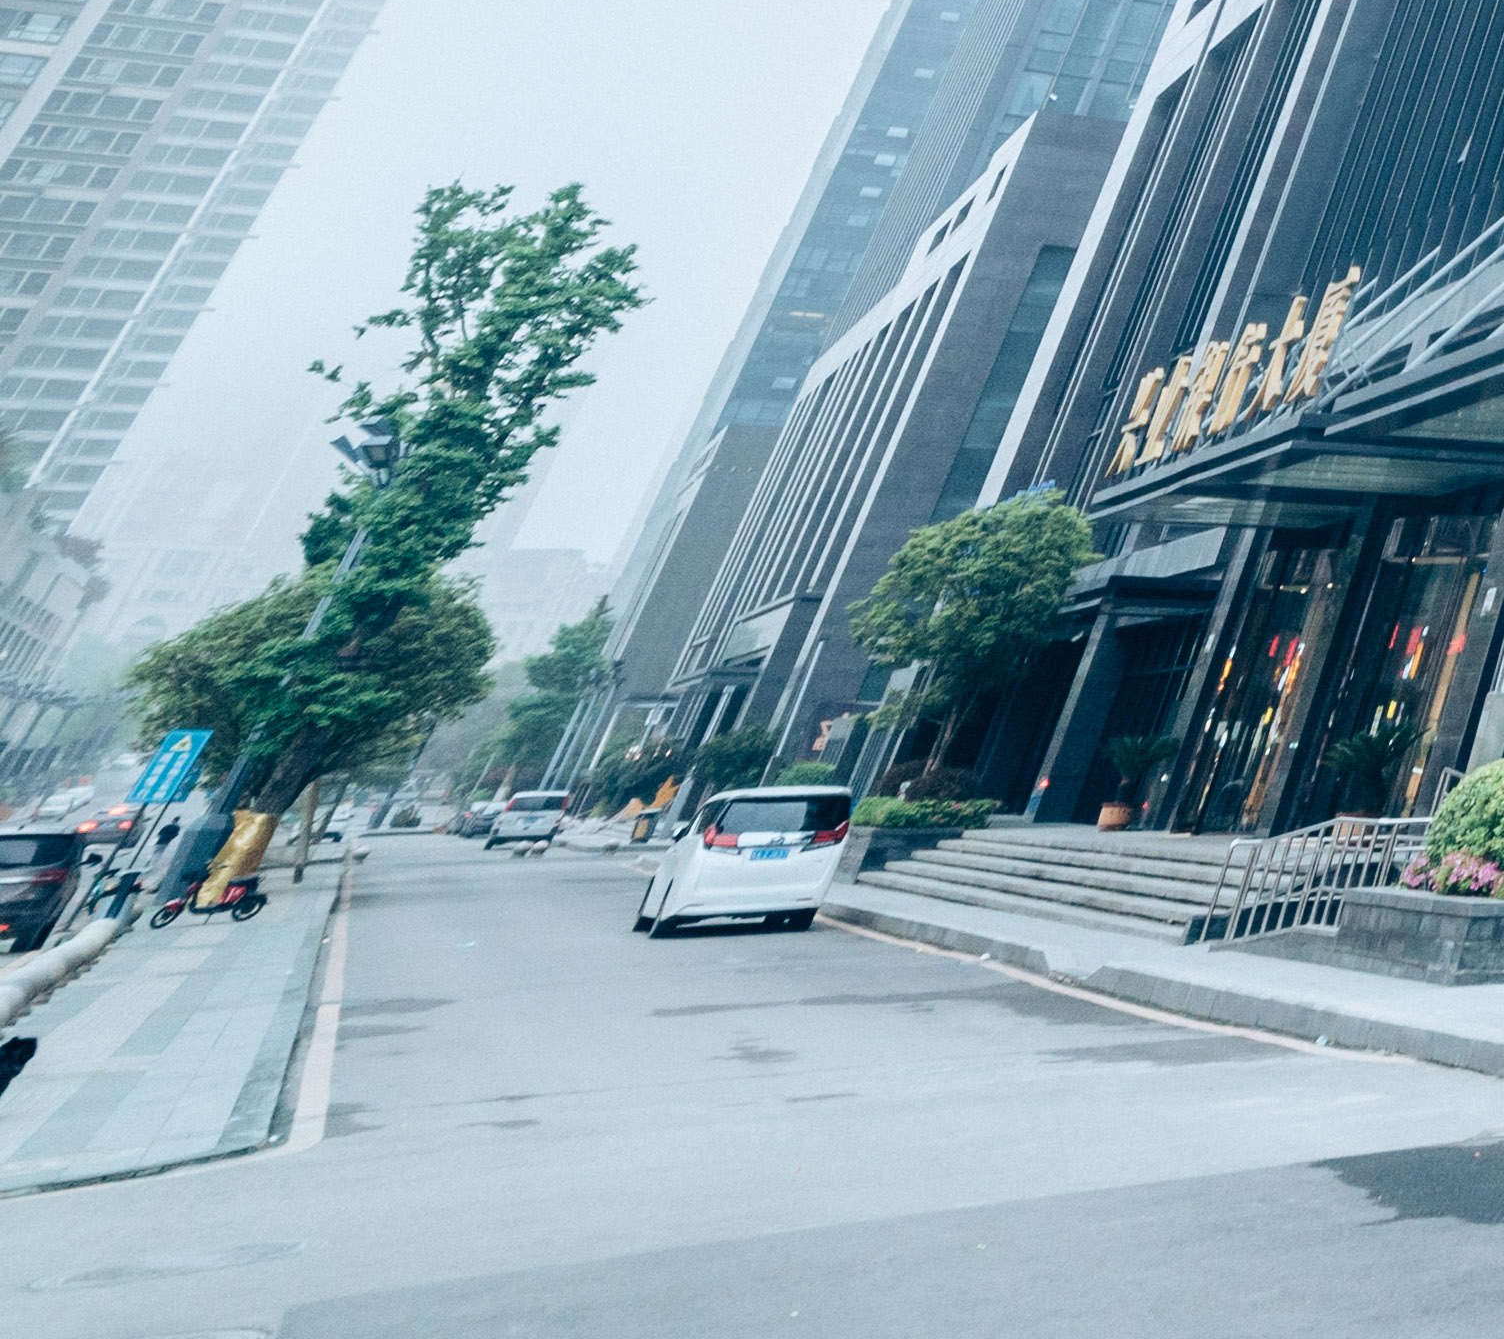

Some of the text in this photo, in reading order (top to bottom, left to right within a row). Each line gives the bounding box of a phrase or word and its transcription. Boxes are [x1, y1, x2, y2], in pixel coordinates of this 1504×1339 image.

[1105, 266, 1361, 478] 兴业银行大厦
